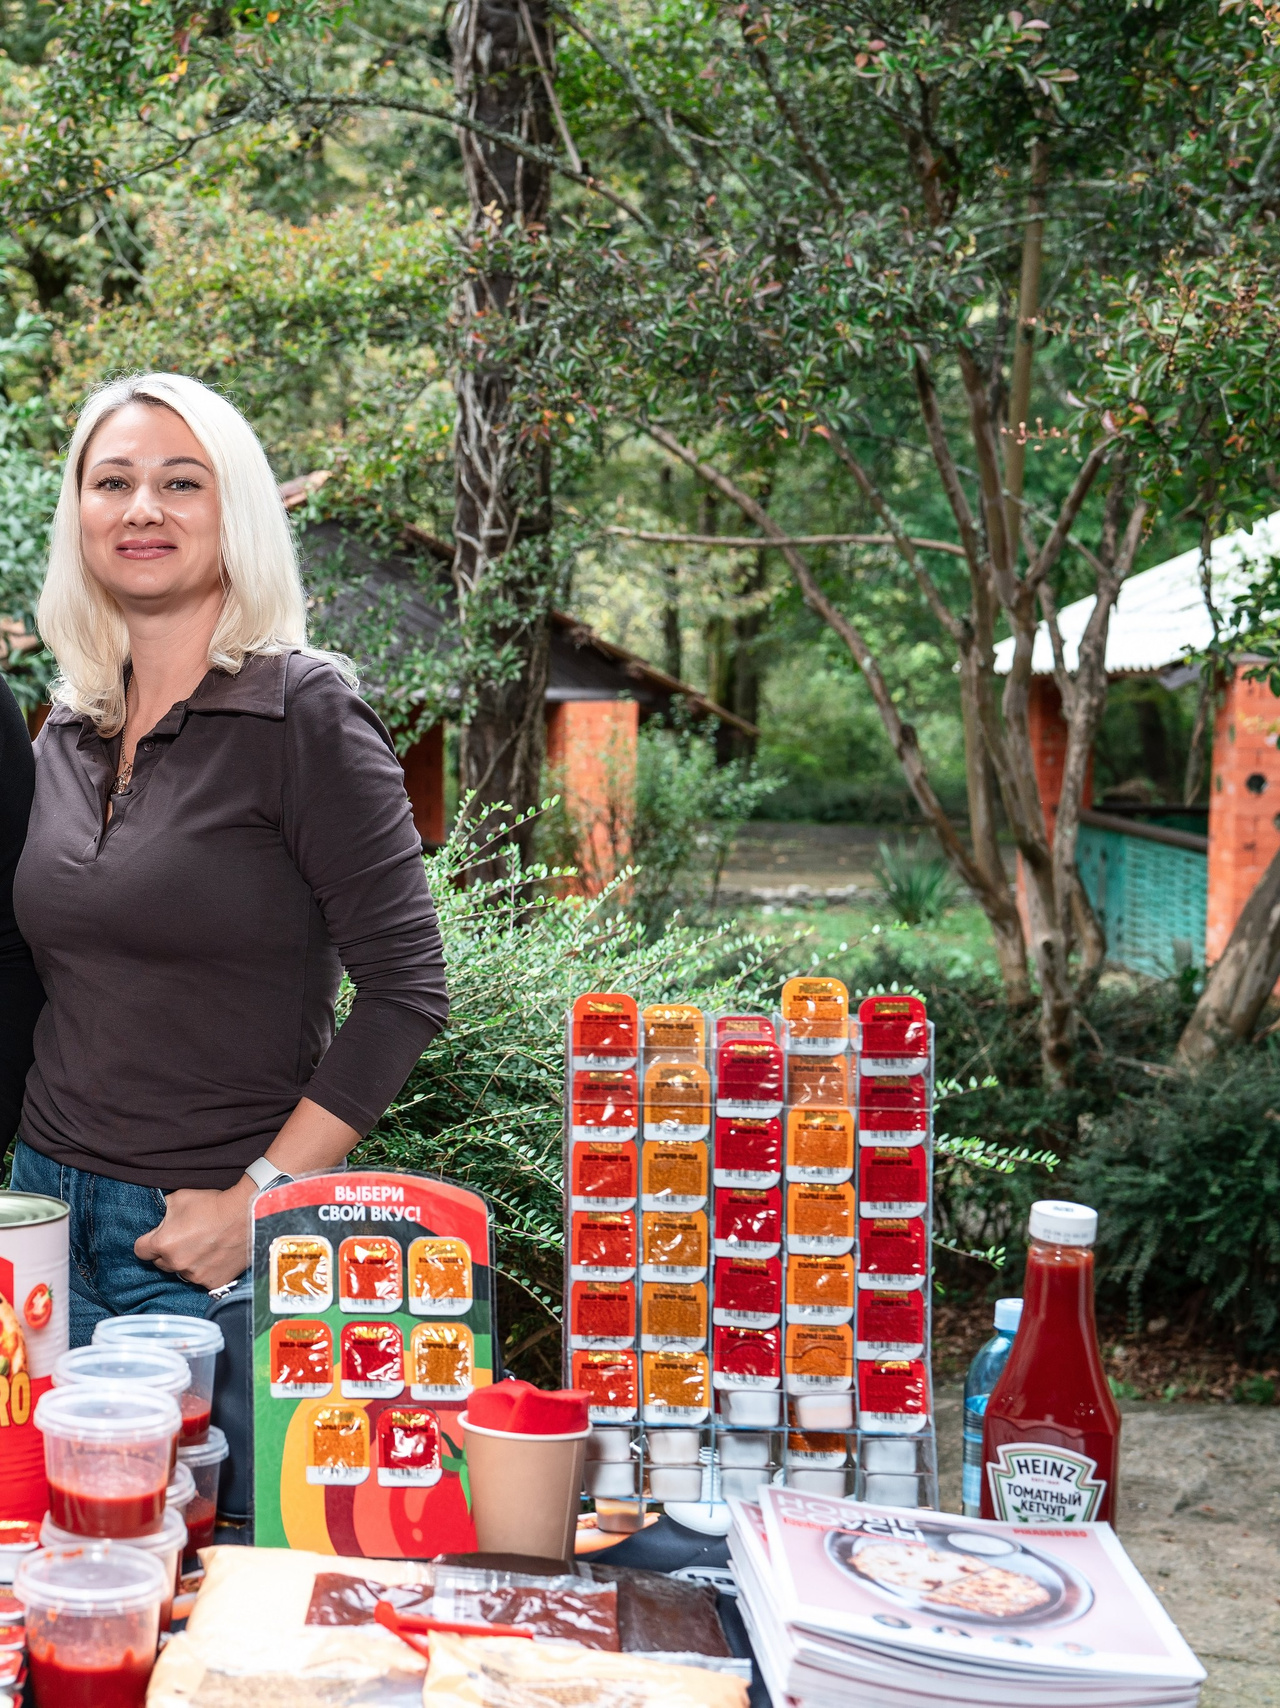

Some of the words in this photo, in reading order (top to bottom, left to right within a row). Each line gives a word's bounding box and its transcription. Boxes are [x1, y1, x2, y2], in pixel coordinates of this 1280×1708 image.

[334, 1185, 404, 1202] ВЫБЕРИ
[318, 1202, 366, 1222] СВОЙ
[370, 1205, 421, 1222] ВКУС!
[1016, 1458, 1077, 1483] HEINZ
[1006, 1482, 1082, 1507] ТОМАТНЫЙ
[776, 1494, 920, 1532] НОВЫЕ
[1020, 1499, 1066, 1517] КЕТЧУП
[779, 1506, 927, 1543] СОУСЫ
